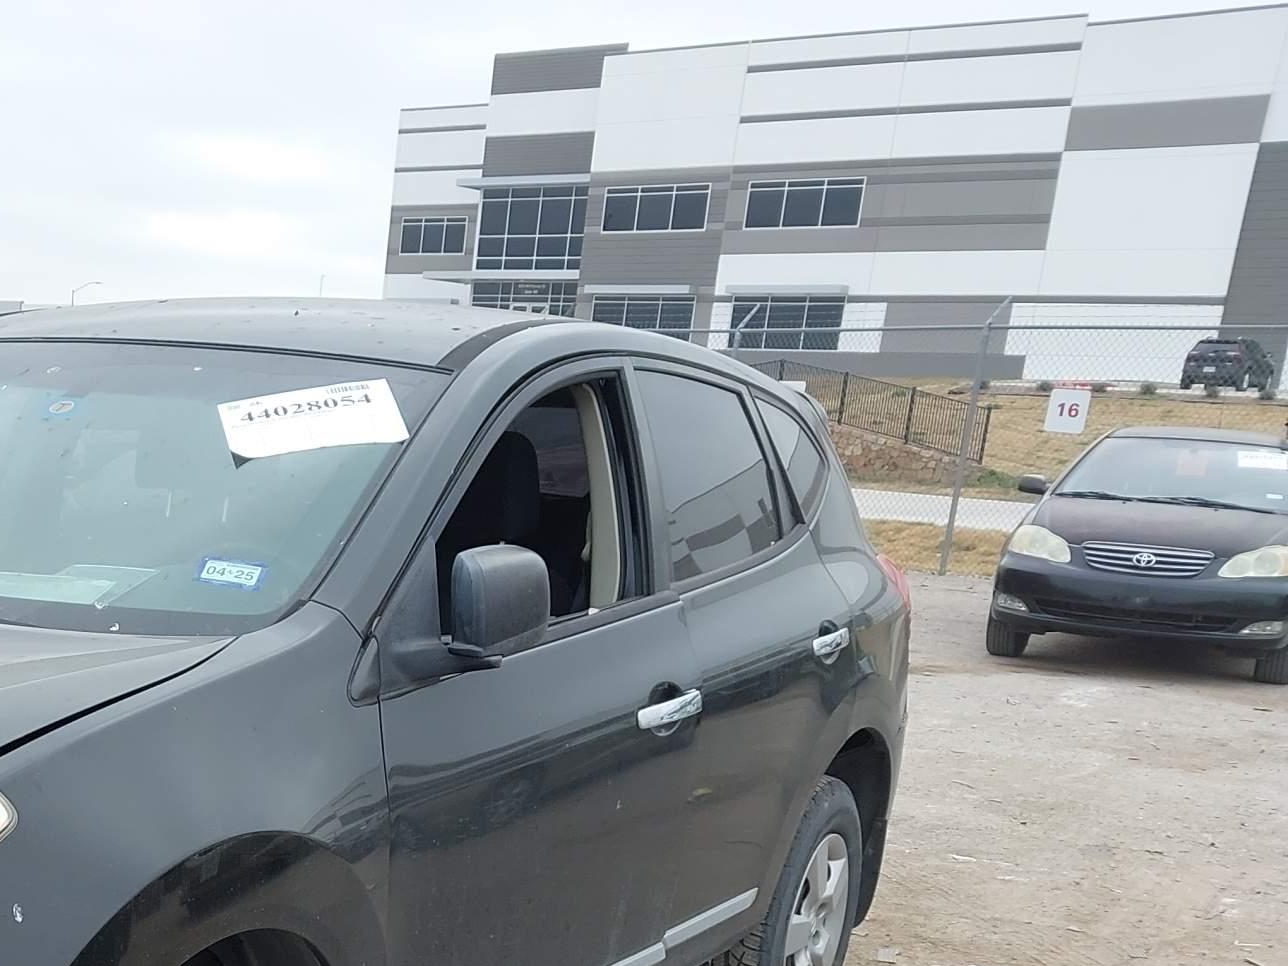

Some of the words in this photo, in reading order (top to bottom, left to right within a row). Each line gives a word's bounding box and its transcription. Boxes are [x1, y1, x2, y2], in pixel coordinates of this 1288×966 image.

[240, 393, 372, 422] 44028054
[1057, 402, 1080, 418] 16
[206, 565, 226, 577] 04
[234, 569, 256, 581] 25
